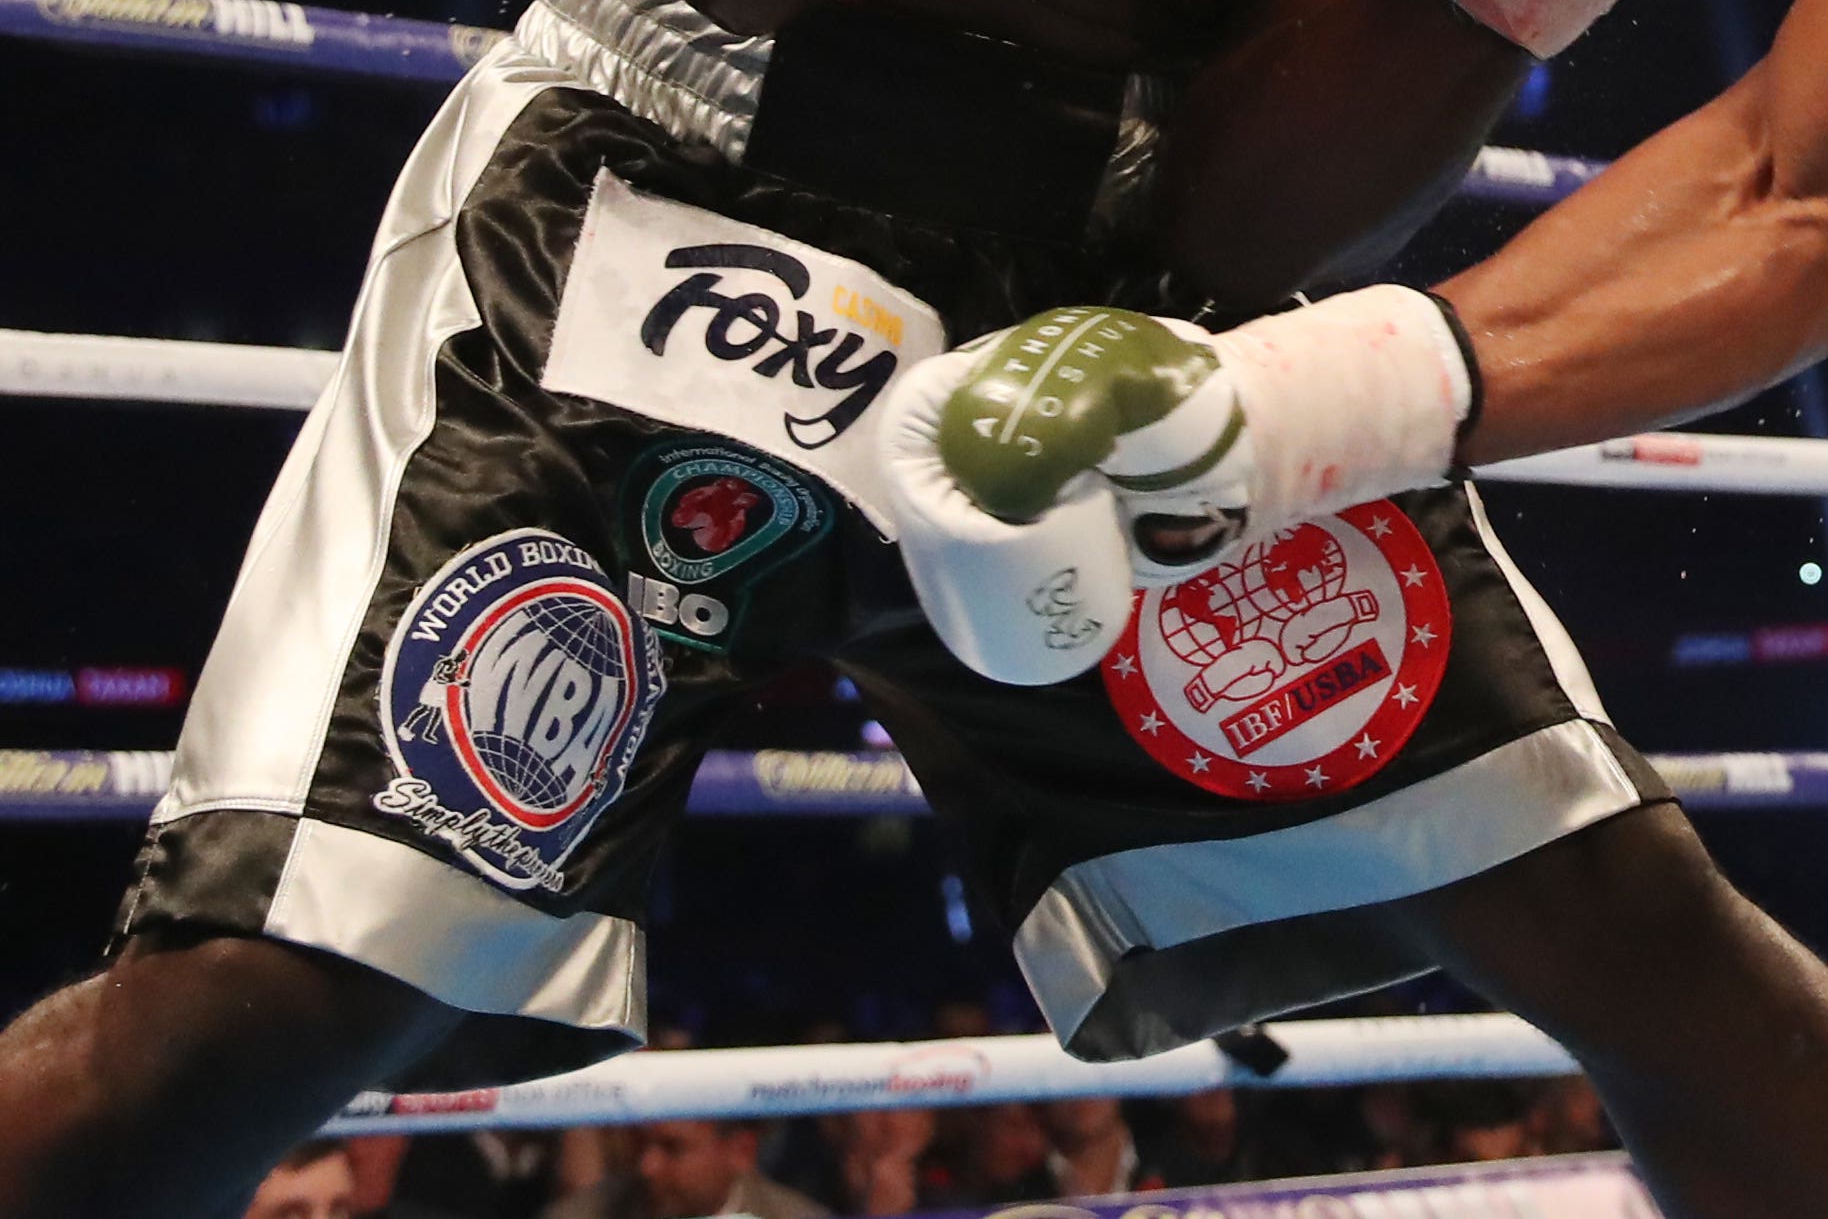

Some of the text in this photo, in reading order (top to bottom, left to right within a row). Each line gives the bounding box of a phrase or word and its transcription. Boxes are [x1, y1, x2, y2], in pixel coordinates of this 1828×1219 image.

[641, 244, 897, 450] Foxy
[411, 551, 513, 643] WORLD
[628, 571, 730, 636] IBO
[652, 540, 715, 578] BOXING
[468, 609, 621, 801] WBA
[1227, 651, 1383, 740] IBF/USBA
